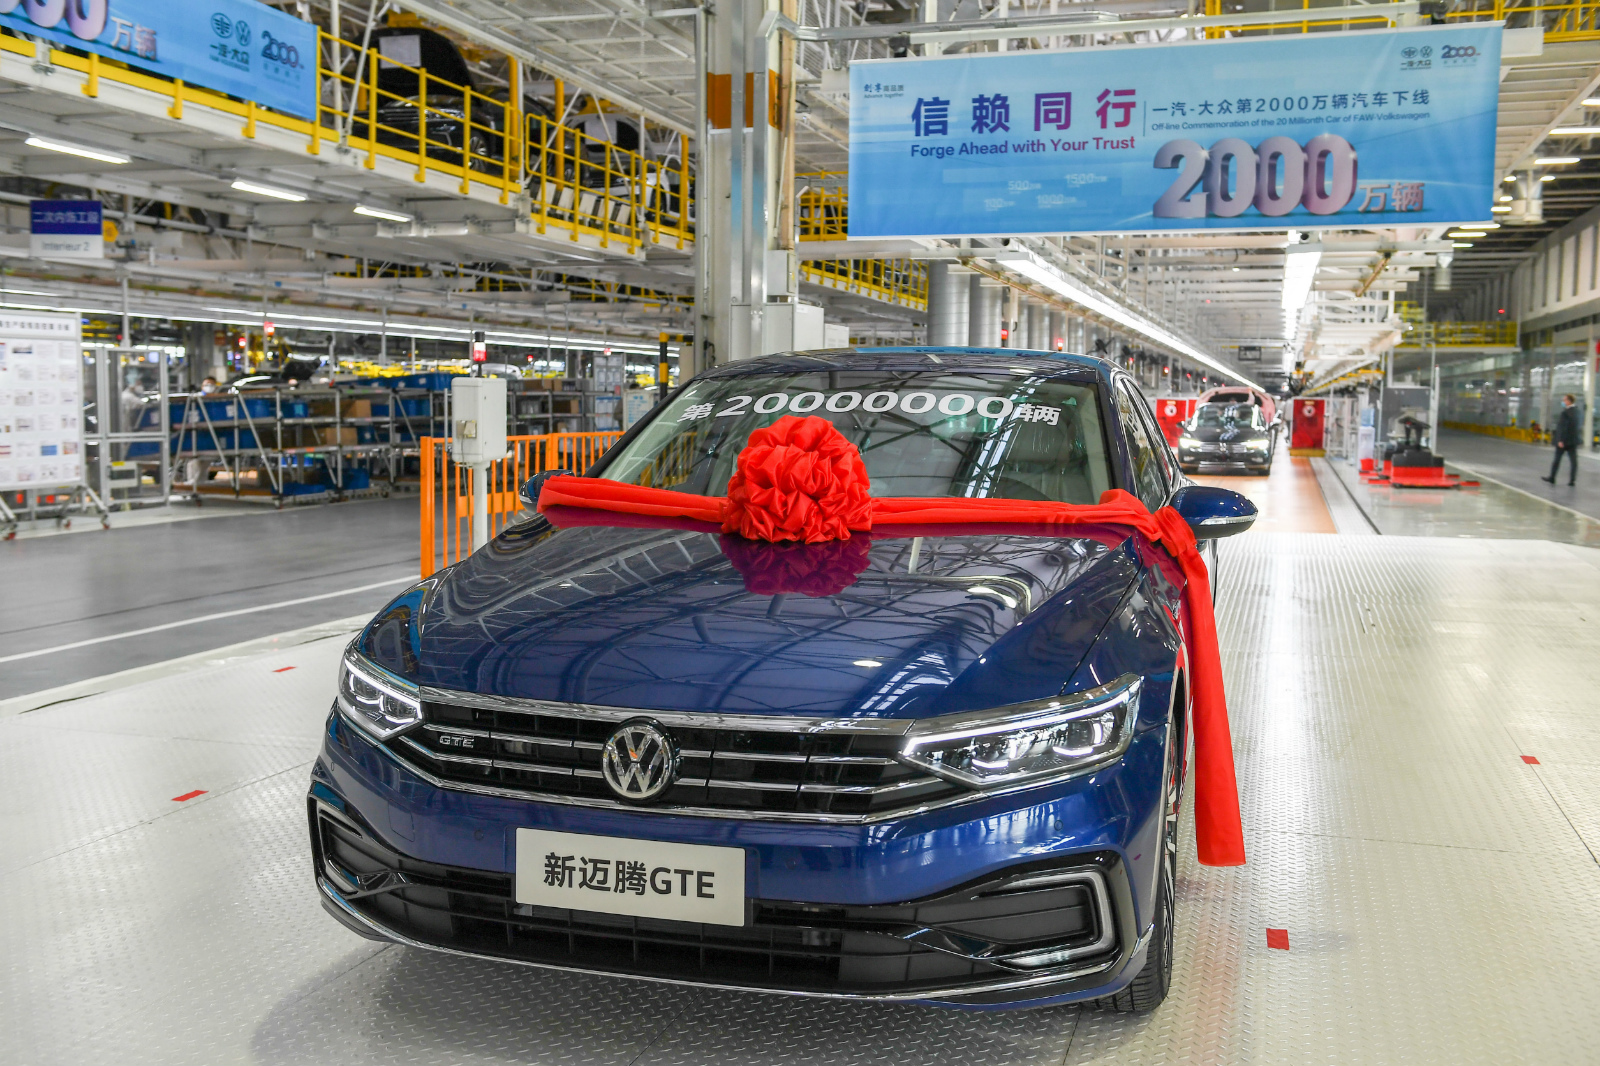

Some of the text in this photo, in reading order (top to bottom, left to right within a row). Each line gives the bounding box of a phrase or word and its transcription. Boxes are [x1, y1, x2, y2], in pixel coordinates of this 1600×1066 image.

[911, 88, 1137, 137] 信赖同行
[1152, 111, 1430, 131] Off-line Commemoration of the 20 Millionth Car of FAW-Volkswagen
[911, 136, 1135, 159] Forge Ahead with Your Trust
[439, 734, 475, 749] GTE
[543, 852, 715, 899] 新迈腾GTE
